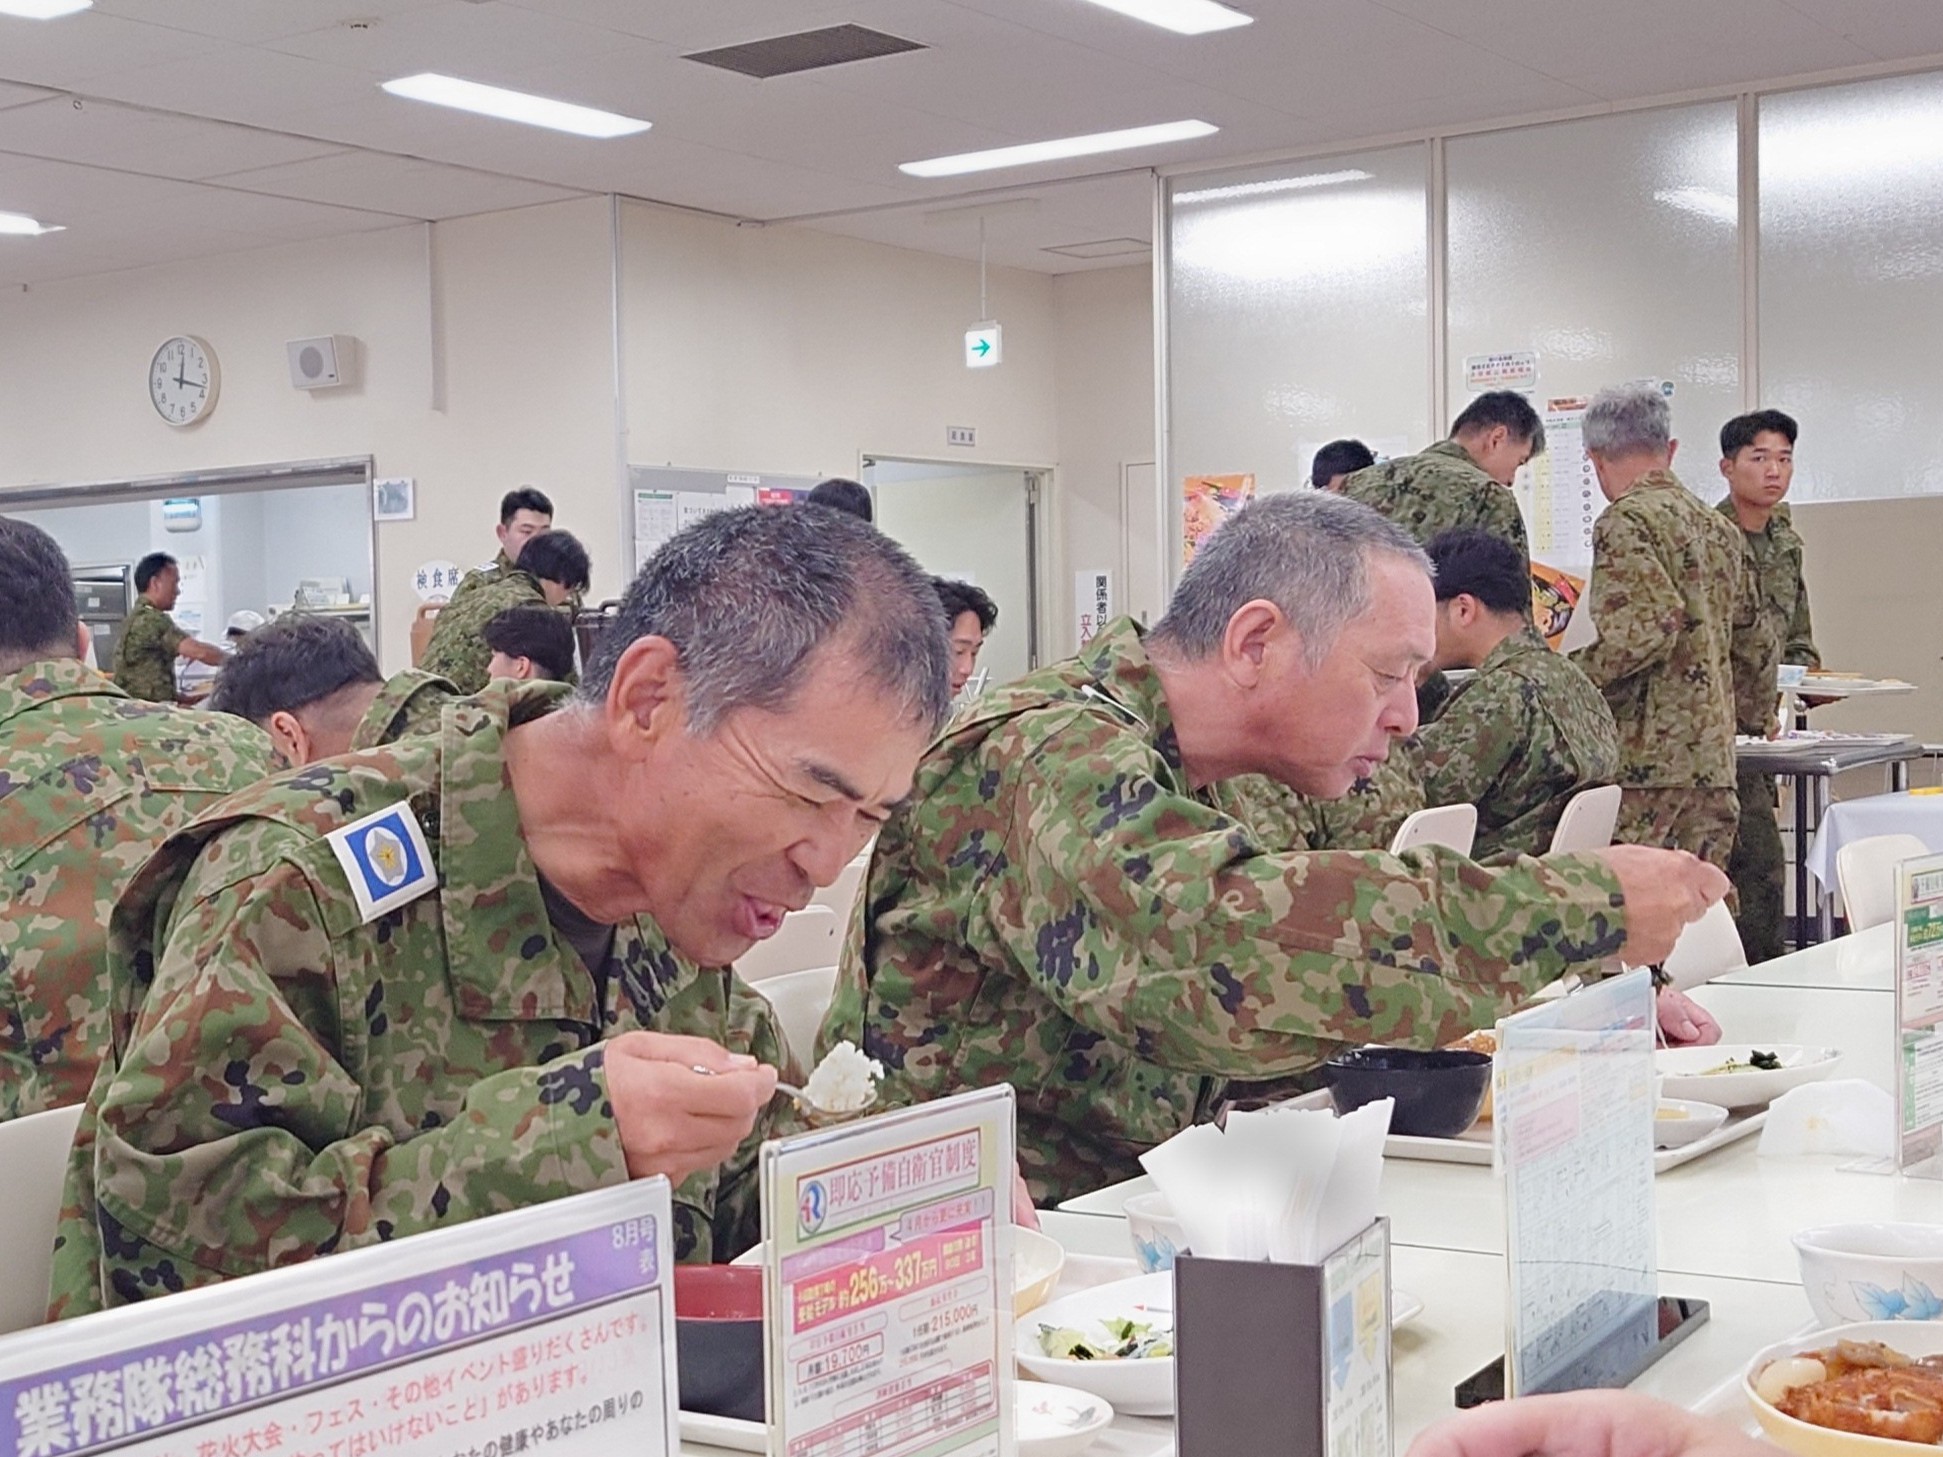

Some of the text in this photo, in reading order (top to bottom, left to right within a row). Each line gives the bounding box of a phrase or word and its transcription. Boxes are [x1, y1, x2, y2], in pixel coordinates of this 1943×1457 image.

[167, 349, 174, 361] 11
[159, 362, 167, 373] 10
[198, 357, 204, 369] 2
[157, 377, 162, 390] 9
[202, 373, 208, 385] 3
[161, 393, 167, 404] 8
[199, 389, 206, 399] 4
[170, 403, 176, 415] 7
[180, 406, 186, 418] 6
[190, 401, 197, 413] 5
[1096, 575, 1108, 631] 関係者以
[829, 1138, 977, 1206] 即応予備自衛官制度
[15, 1251, 576, 1457] 業務隊総務科からのお知らせ
